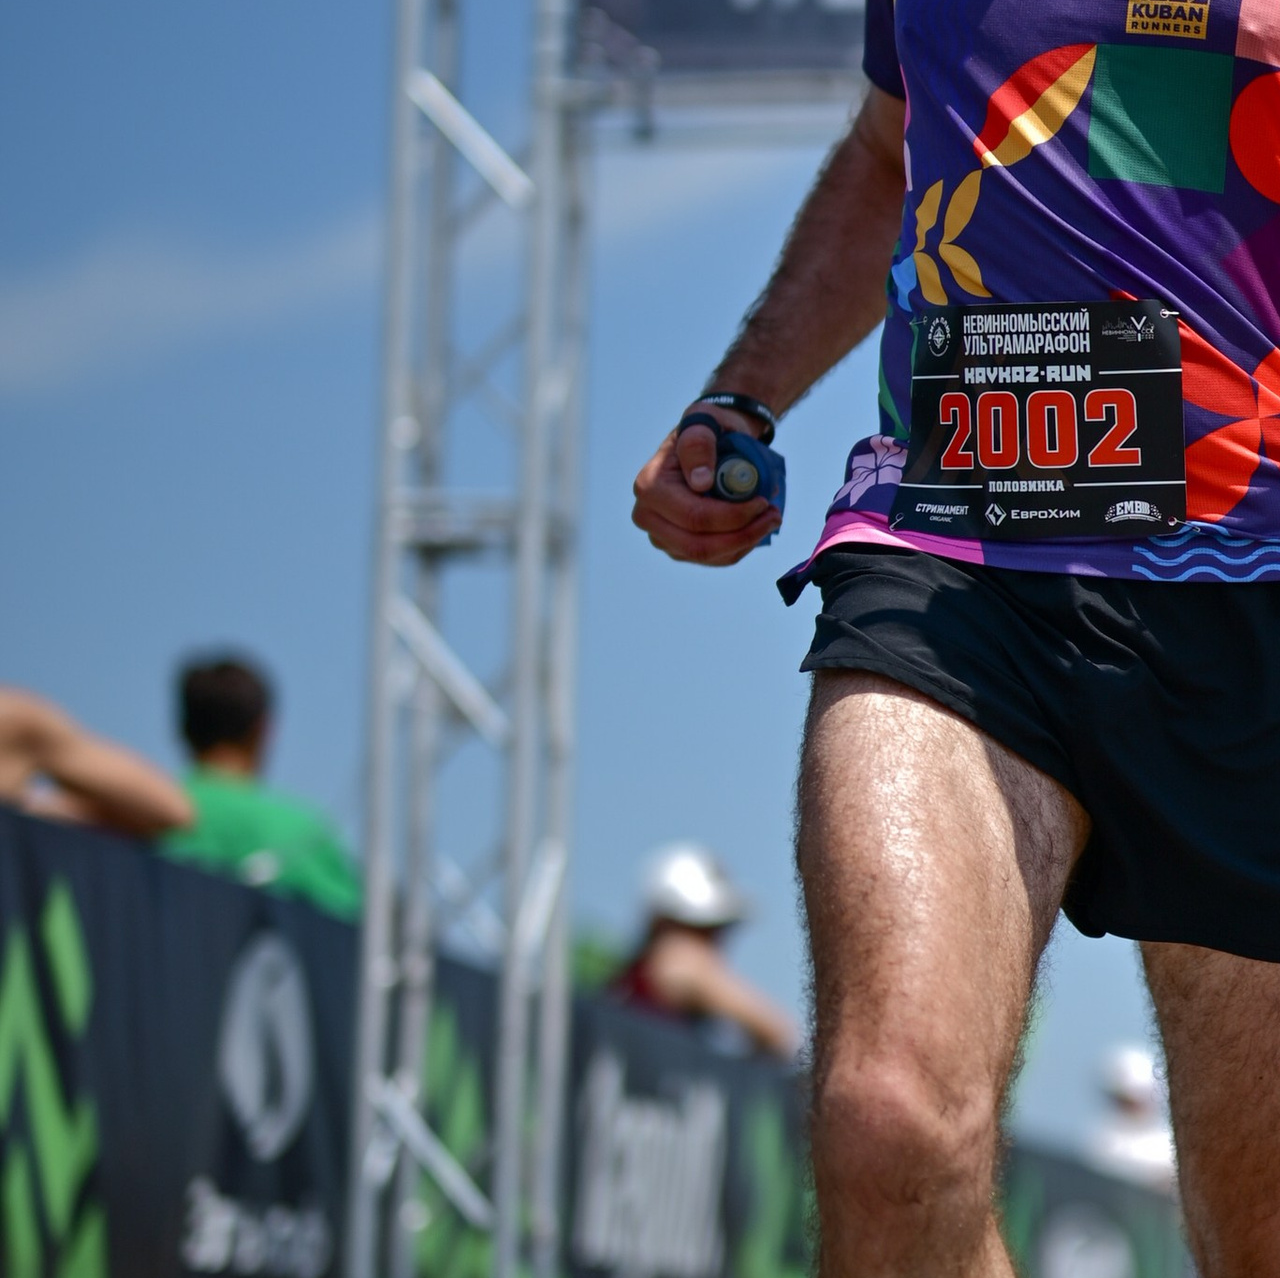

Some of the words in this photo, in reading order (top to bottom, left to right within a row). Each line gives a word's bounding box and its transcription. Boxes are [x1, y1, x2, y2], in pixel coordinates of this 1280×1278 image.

[1131, 3, 1204, 23] KUBAN
[1131, 21, 1201, 34] RUNNERS
[963, 308, 1090, 334] НЕВИННОМЫССКИЙ
[963, 332, 1091, 356] УЛЬТРАМАРАФОН
[939, 388, 1142, 471] 2002
[988, 479, 1065, 493] ПОЛОВИНКА
[915, 502, 969, 516] СТРИЖАМЕНТ
